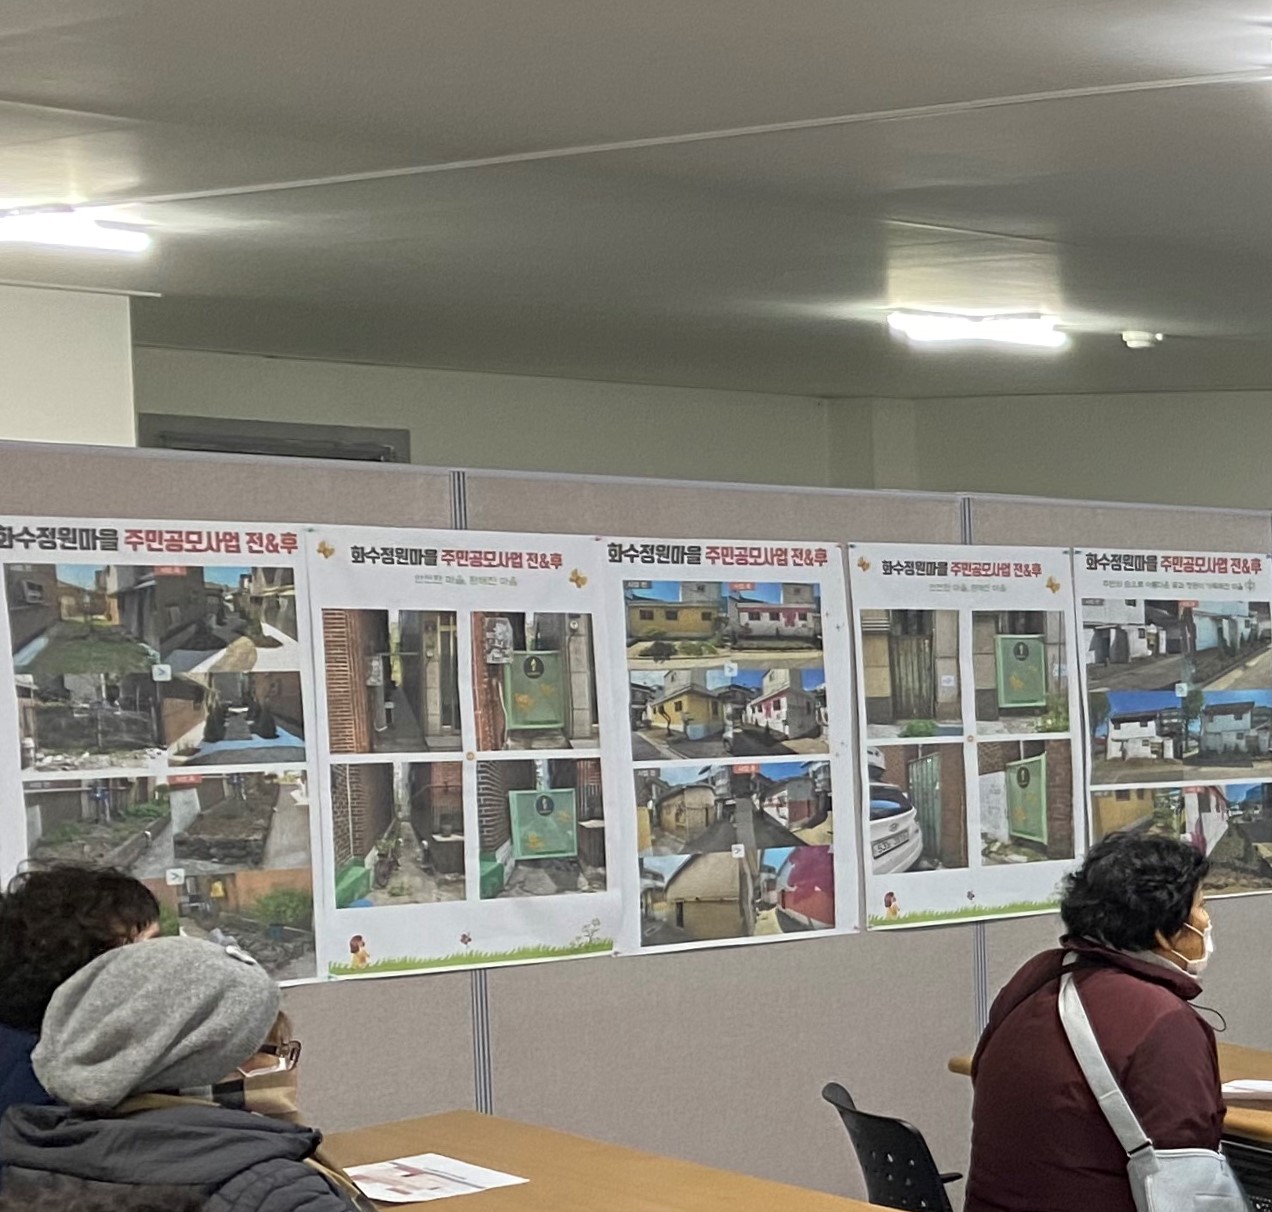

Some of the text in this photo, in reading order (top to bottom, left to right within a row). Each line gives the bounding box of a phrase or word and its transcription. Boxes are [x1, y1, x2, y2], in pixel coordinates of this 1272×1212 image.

[0, 523, 299, 554] 화수정원마을 주민공모사업 전&후
[350, 545, 563, 570] 화수정원마을 주민공모사업 전&후
[607, 542, 828, 567] 화수정원마을 주민공모사업 전&후
[1085, 552, 1263, 576] 화수정원마을 주민공모사업 전&후
[882, 559, 1043, 578] 화수정원마을 주민공모사업 전&후
